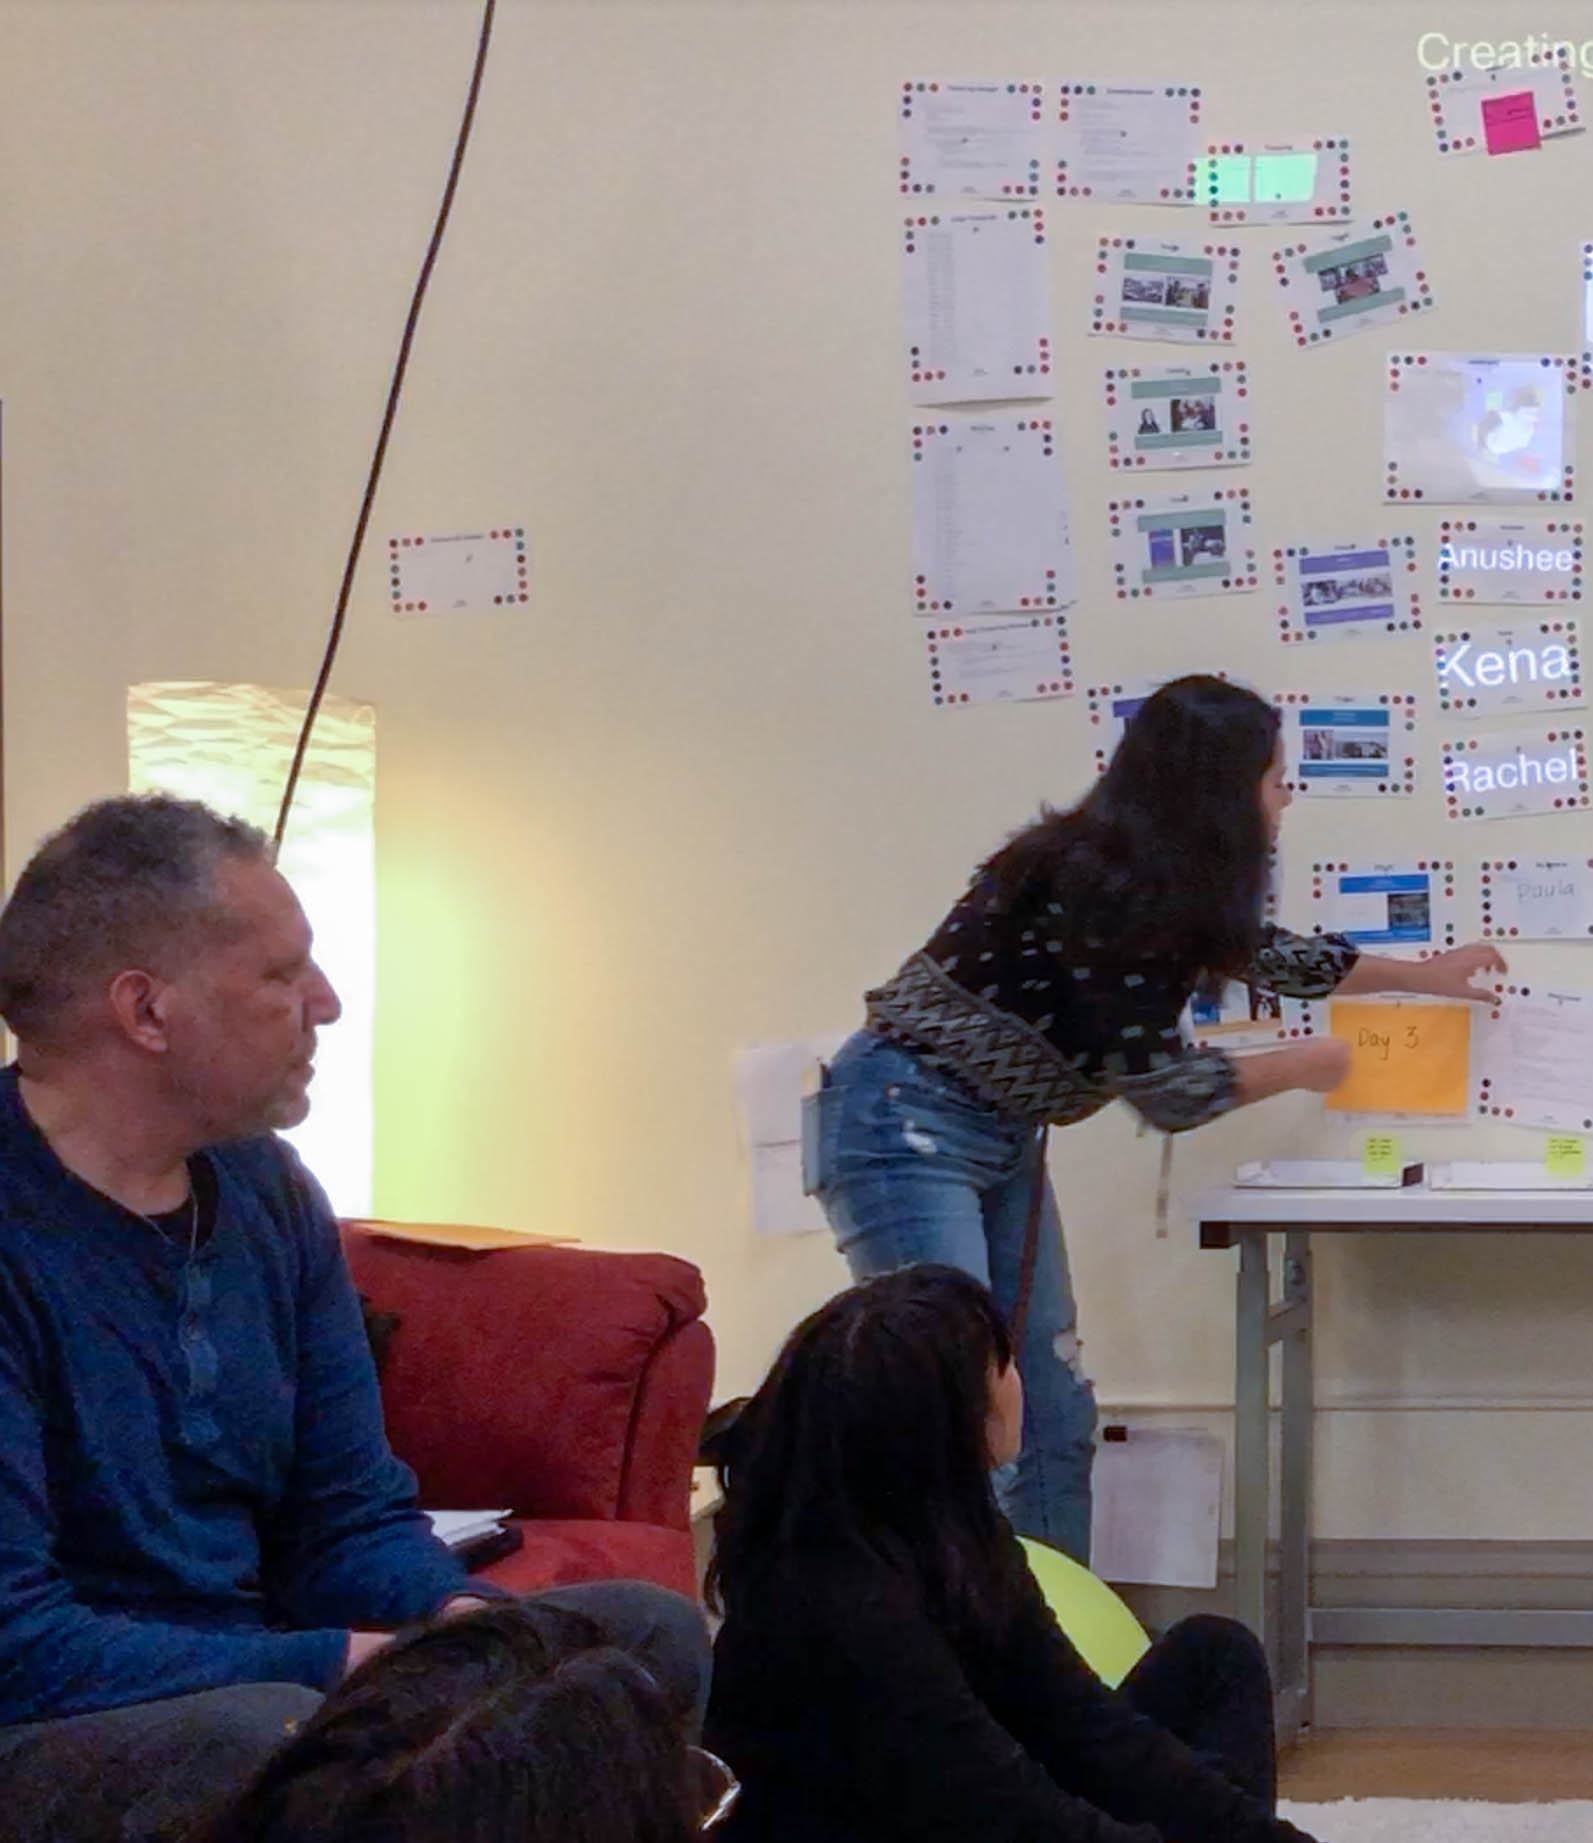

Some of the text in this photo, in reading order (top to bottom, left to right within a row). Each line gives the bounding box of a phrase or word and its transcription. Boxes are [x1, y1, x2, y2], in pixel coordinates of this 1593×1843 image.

[1437, 543, 1573, 571] Anushee
[1437, 643, 1572, 688] Kena
[1443, 748, 1578, 795] Rachel
[1358, 1025, 1418, 1061] Day 3
